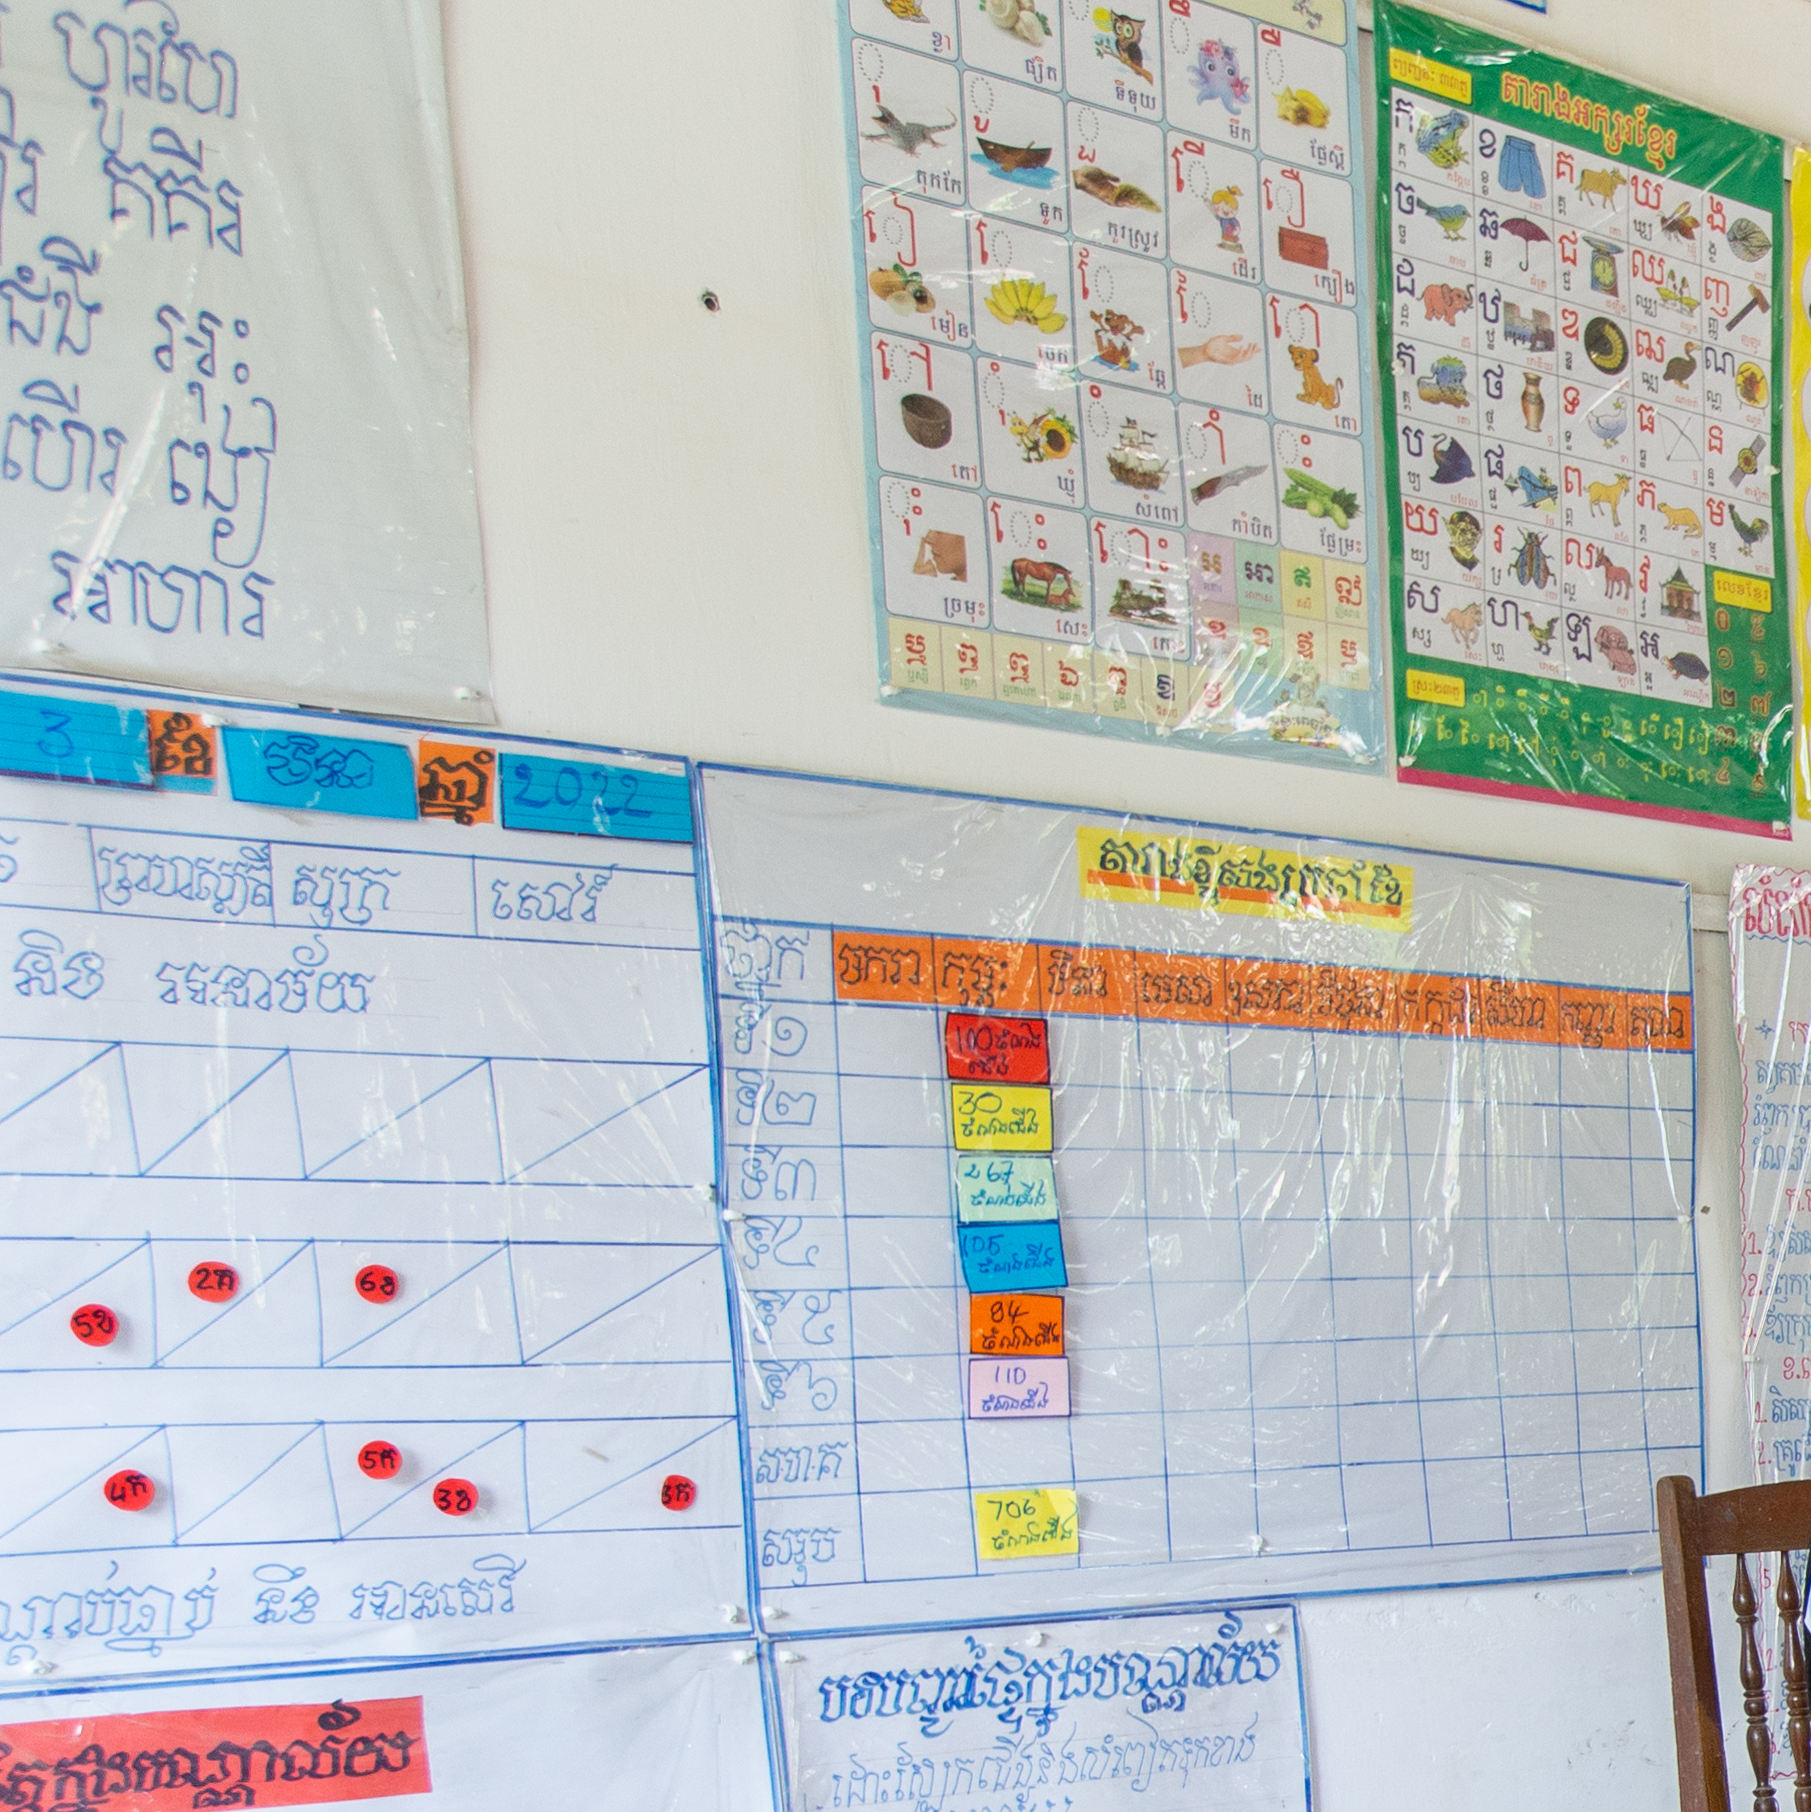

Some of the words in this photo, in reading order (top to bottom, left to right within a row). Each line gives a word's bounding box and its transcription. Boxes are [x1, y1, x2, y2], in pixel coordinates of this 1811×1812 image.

[1503, 73, 1678, 170] តារាងអក្សរខ្មែរ
[513, 763, 653, 817] 2022
[958, 1091, 1003, 1116] 30
